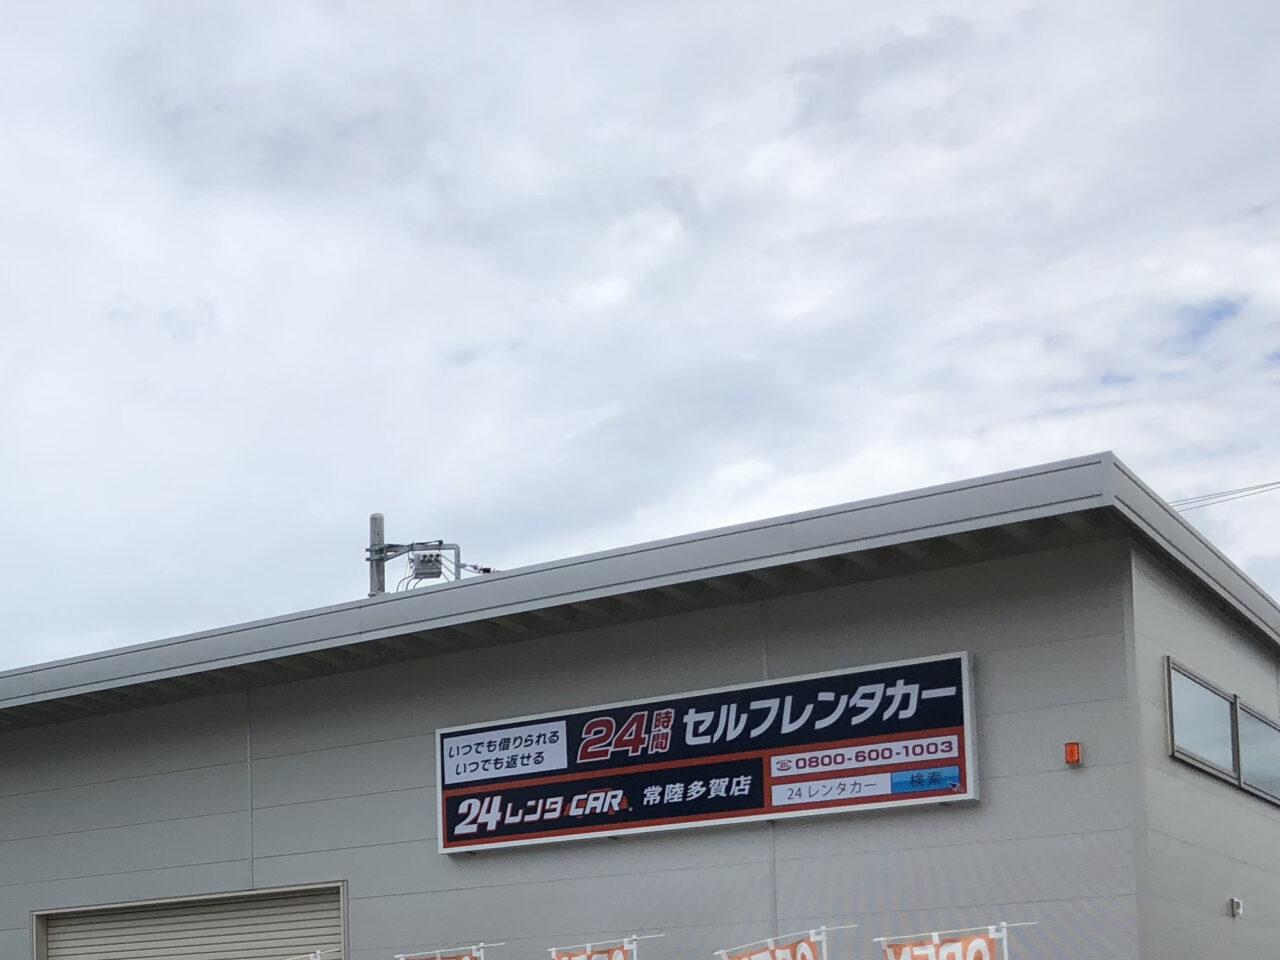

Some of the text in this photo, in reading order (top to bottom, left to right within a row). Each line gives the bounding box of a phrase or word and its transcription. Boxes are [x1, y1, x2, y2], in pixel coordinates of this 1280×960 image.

[448, 731, 560, 759] いつでも借りられる
[795, 740, 954, 769] 0800-600-1003
[455, 752, 545, 776] いつでも返せる
[643, 775, 752, 806] 常陸多賀店
[910, 772, 940, 788] 検索
